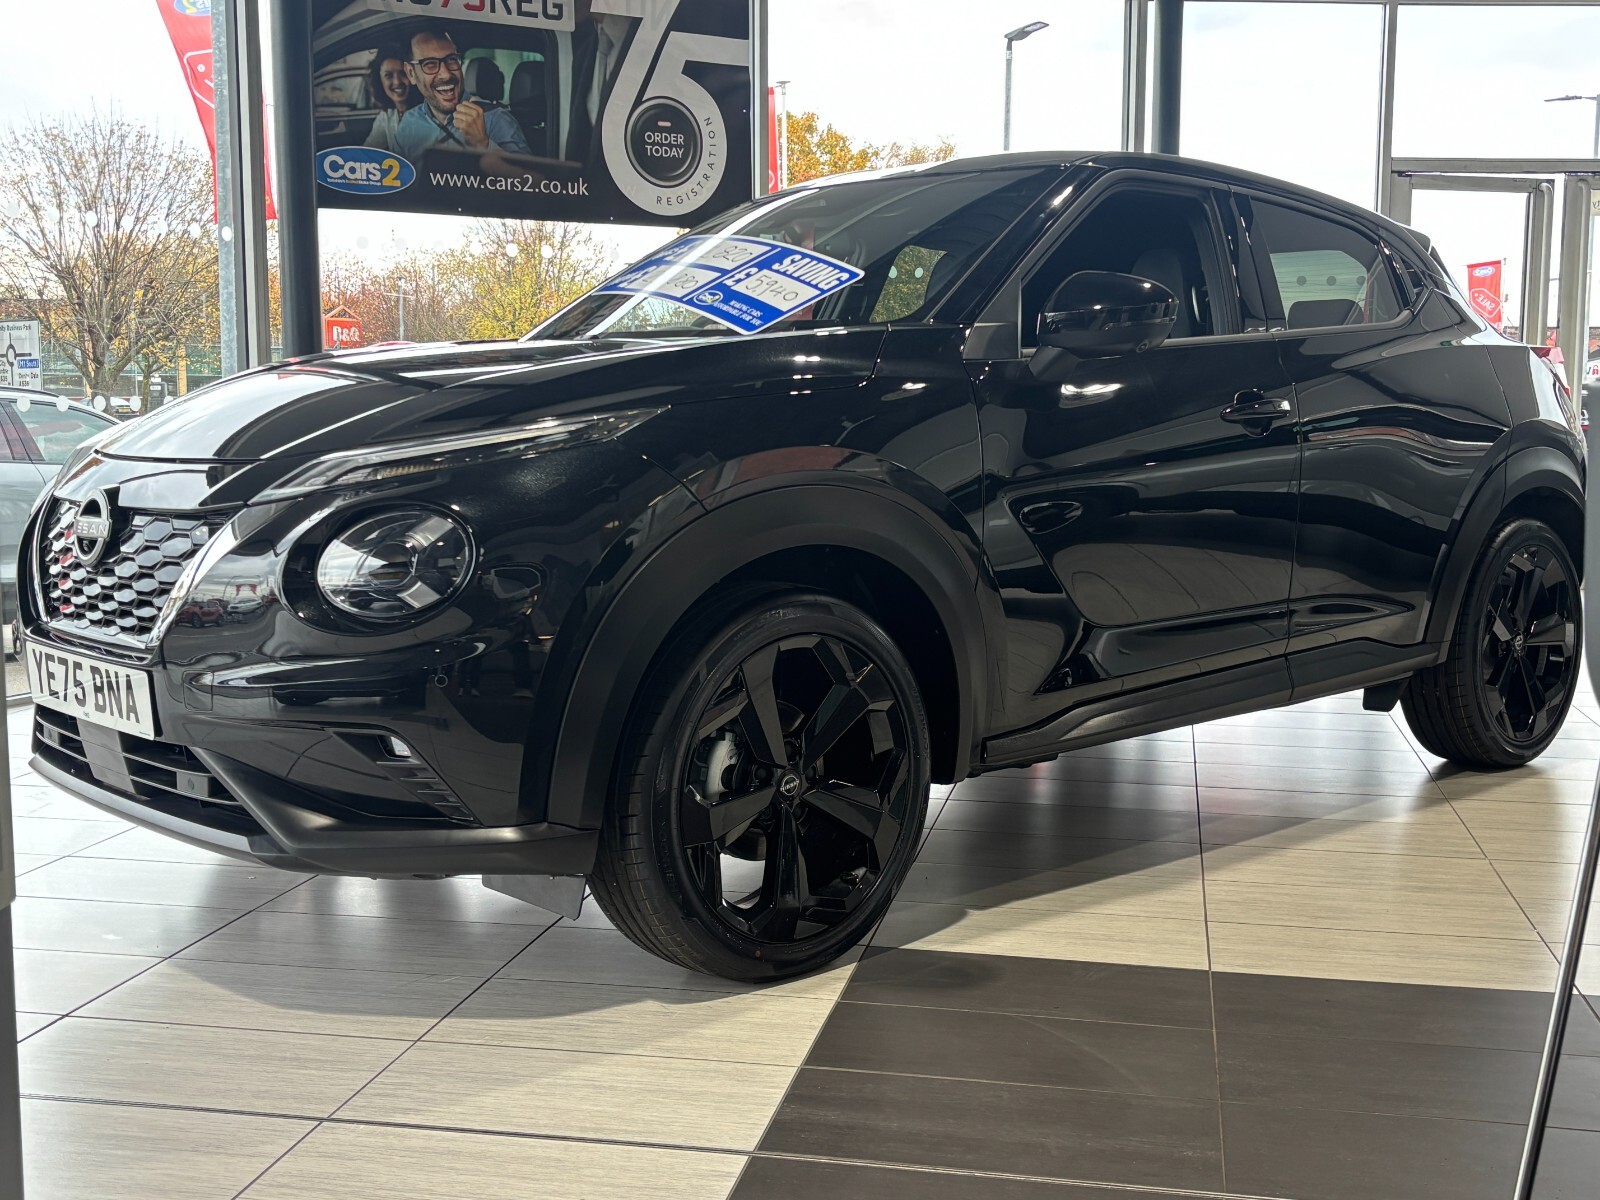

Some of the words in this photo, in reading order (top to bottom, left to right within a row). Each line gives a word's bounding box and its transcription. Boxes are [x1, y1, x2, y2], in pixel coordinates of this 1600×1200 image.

[644, 131, 685, 146] ORDER
[644, 145, 685, 159] TODAY
[655, 116, 718, 207] REGISTRATION
[429, 172, 589, 197] www.cars2.co.uk
[771, 254, 850, 291] SAVING
[32, 648, 87, 709] YE75
[89, 664, 141, 725] BNA
